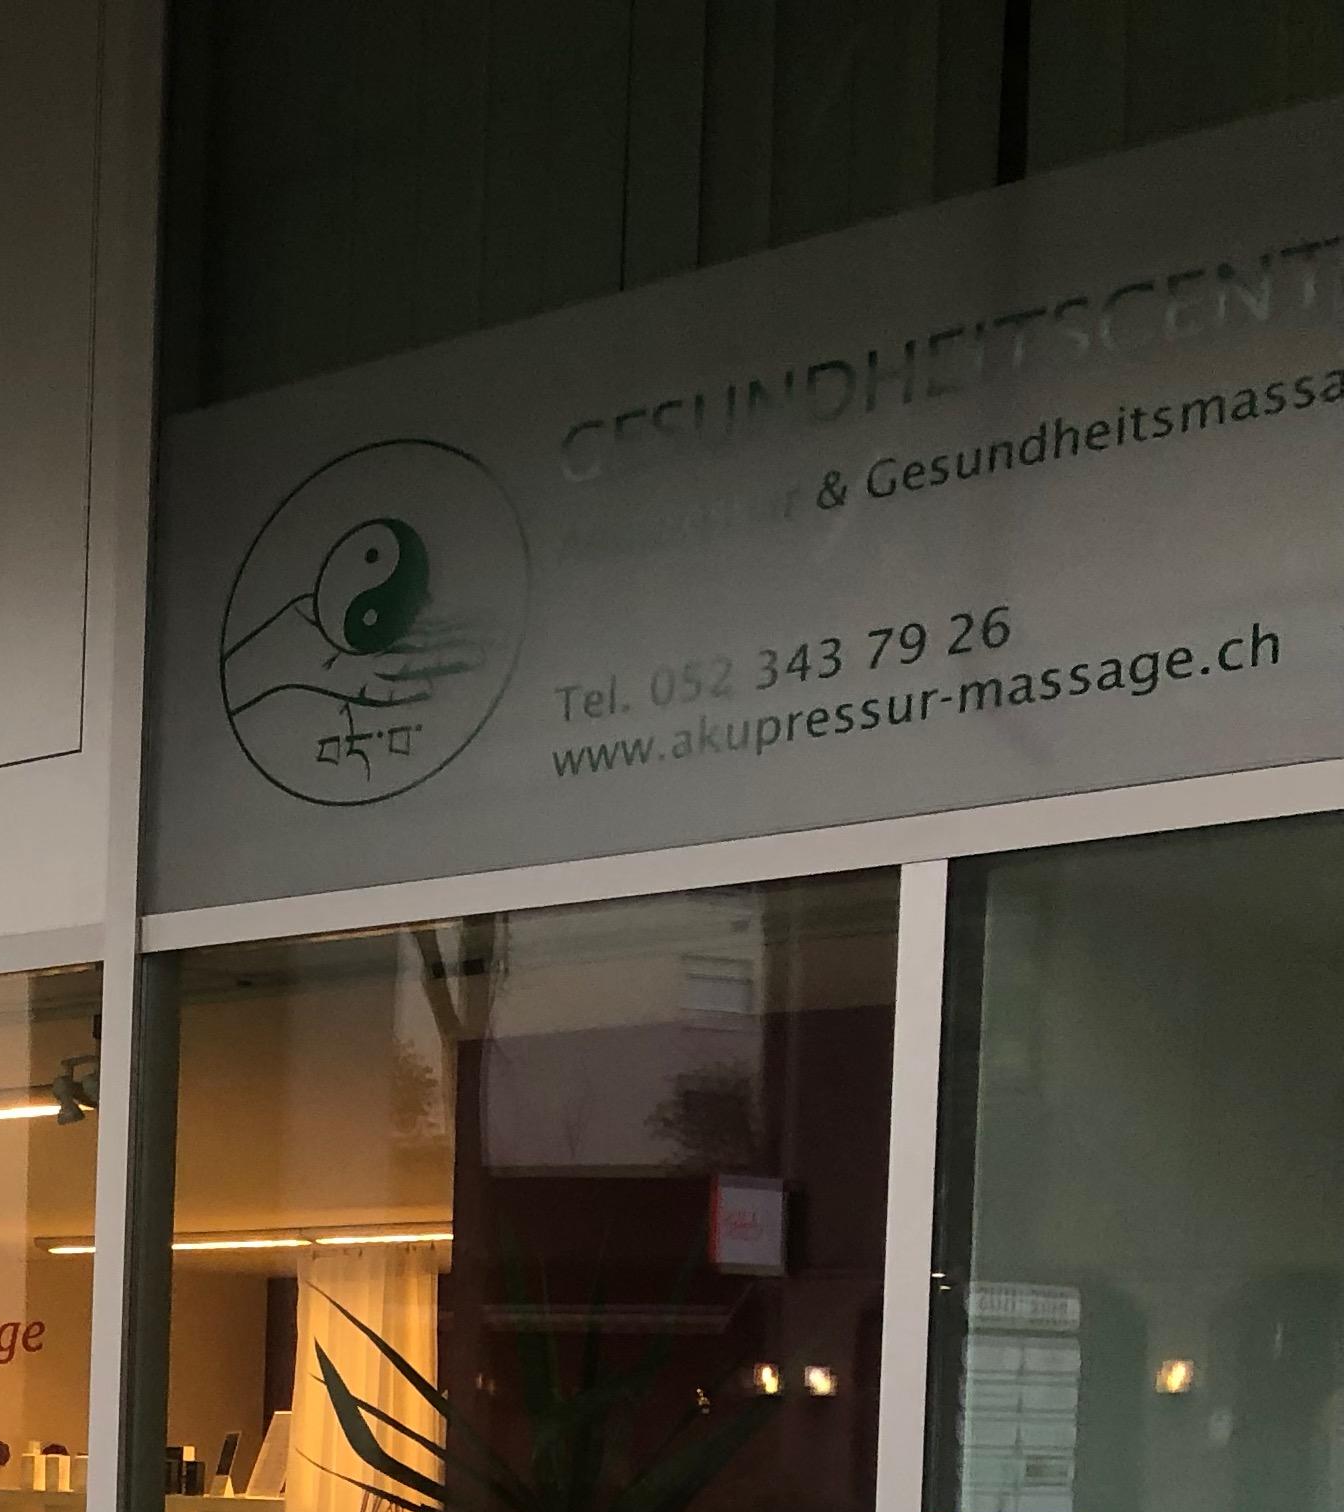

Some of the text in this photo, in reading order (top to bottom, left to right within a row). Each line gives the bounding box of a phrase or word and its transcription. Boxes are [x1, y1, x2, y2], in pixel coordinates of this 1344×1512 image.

[559, 234, 1344, 482] GESUNDHEITSCENT
[816, 366, 1344, 511] & Gesundheitsmassa
[552, 622, 1281, 778] www.akupressur-massage.ch
[555, 604, 1012, 722] Tel. 052 343 79 26
